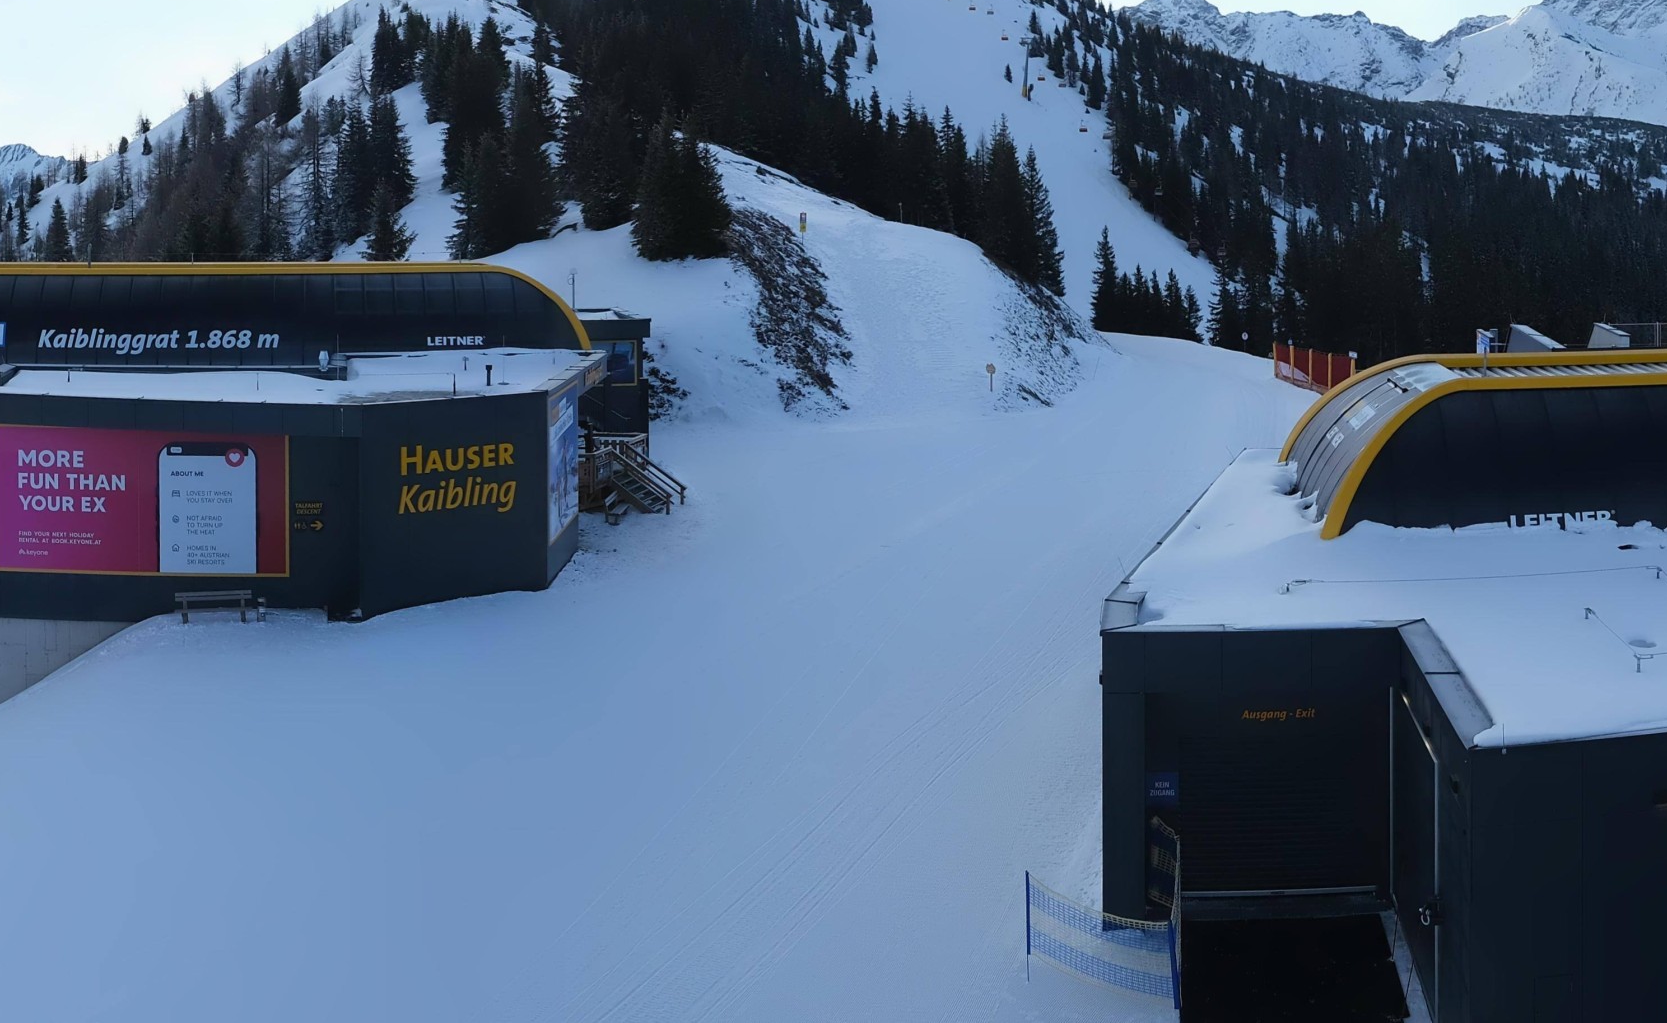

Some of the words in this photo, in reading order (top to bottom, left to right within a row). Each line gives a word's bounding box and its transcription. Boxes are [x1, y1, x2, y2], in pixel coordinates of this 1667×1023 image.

[38, 328, 179, 354] Kaiblinggrat
[185, 330, 251, 348] 1.868
[257, 333, 280, 348] m
[427, 336, 484, 346] LEITNER
[18, 449, 84, 468] MORE
[401, 443, 514, 476] HAUSER
[18, 472, 59, 490] FUN
[66, 473, 126, 491] THAN
[18, 495, 75, 512] YOUR
[81, 497, 106, 513] EX
[398, 476, 516, 514] Kaibling
[1242, 709, 1287, 721] Ausgang
[1295, 708, 1316, 718] Exit
